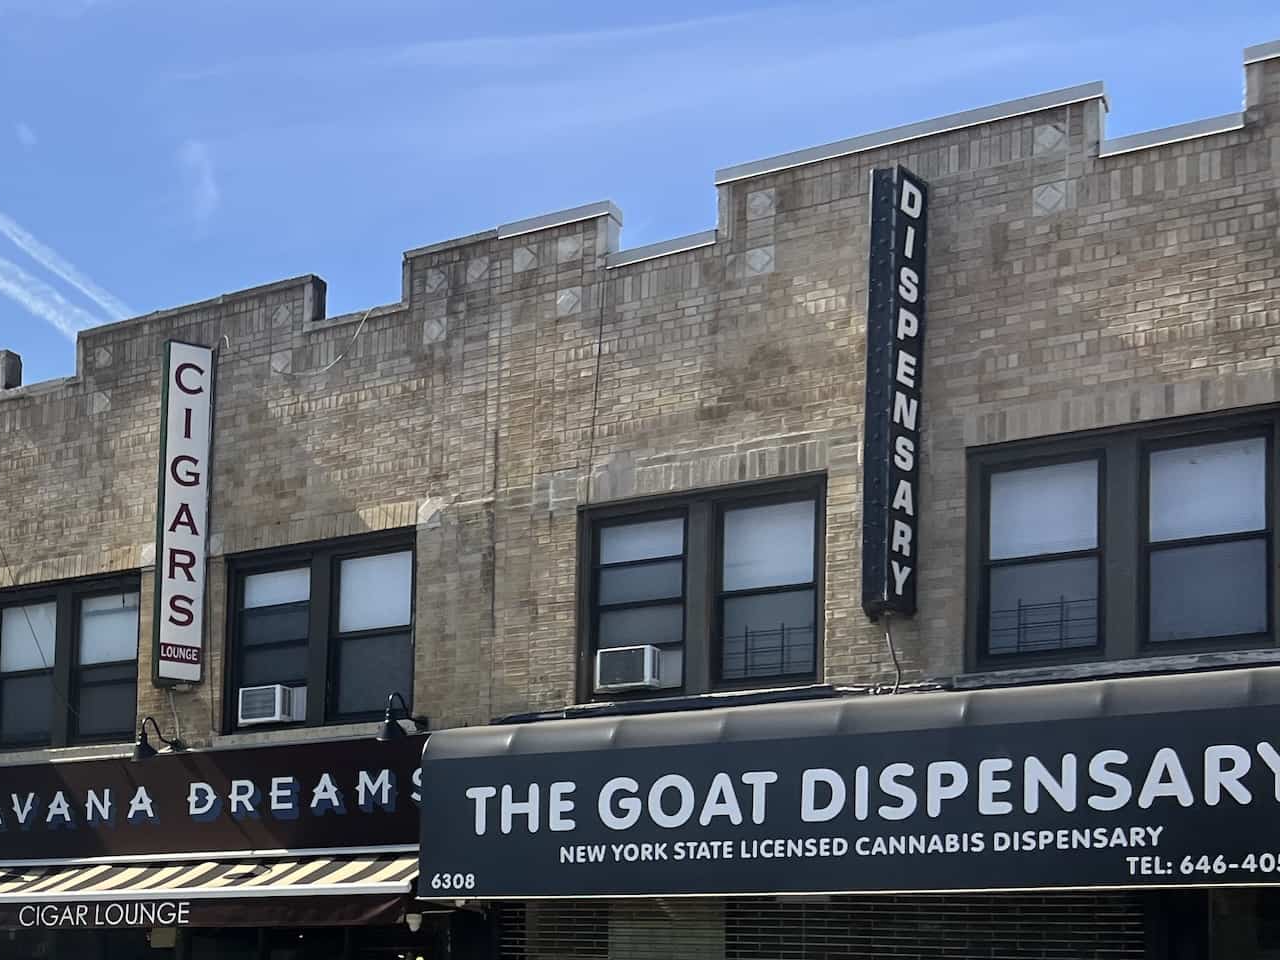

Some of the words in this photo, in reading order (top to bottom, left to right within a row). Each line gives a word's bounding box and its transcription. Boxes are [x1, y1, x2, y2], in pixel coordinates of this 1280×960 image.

[892, 179, 922, 597] DISPENSARY
[168, 362, 205, 627] CIGARS
[161, 645, 198, 662] LOUNGE
[466, 781, 576, 836] THE
[597, 771, 778, 831] GOAT
[559, 844, 607, 864] NEW
[610, 842, 668, 862] YORK
[672, 839, 734, 860] STATE
[740, 837, 848, 858] LICENSED
[855, 832, 984, 856] CANNABIS
[993, 825, 1164, 852] DISPENSARY
[1126, 855, 1172, 876] TEL:
[1179, 852, 1280, 875] 646-40
[431, 873, 475, 889] 6308
[19, 904, 88, 928] CIGAR
[94, 901, 191, 926] LOUNGE
